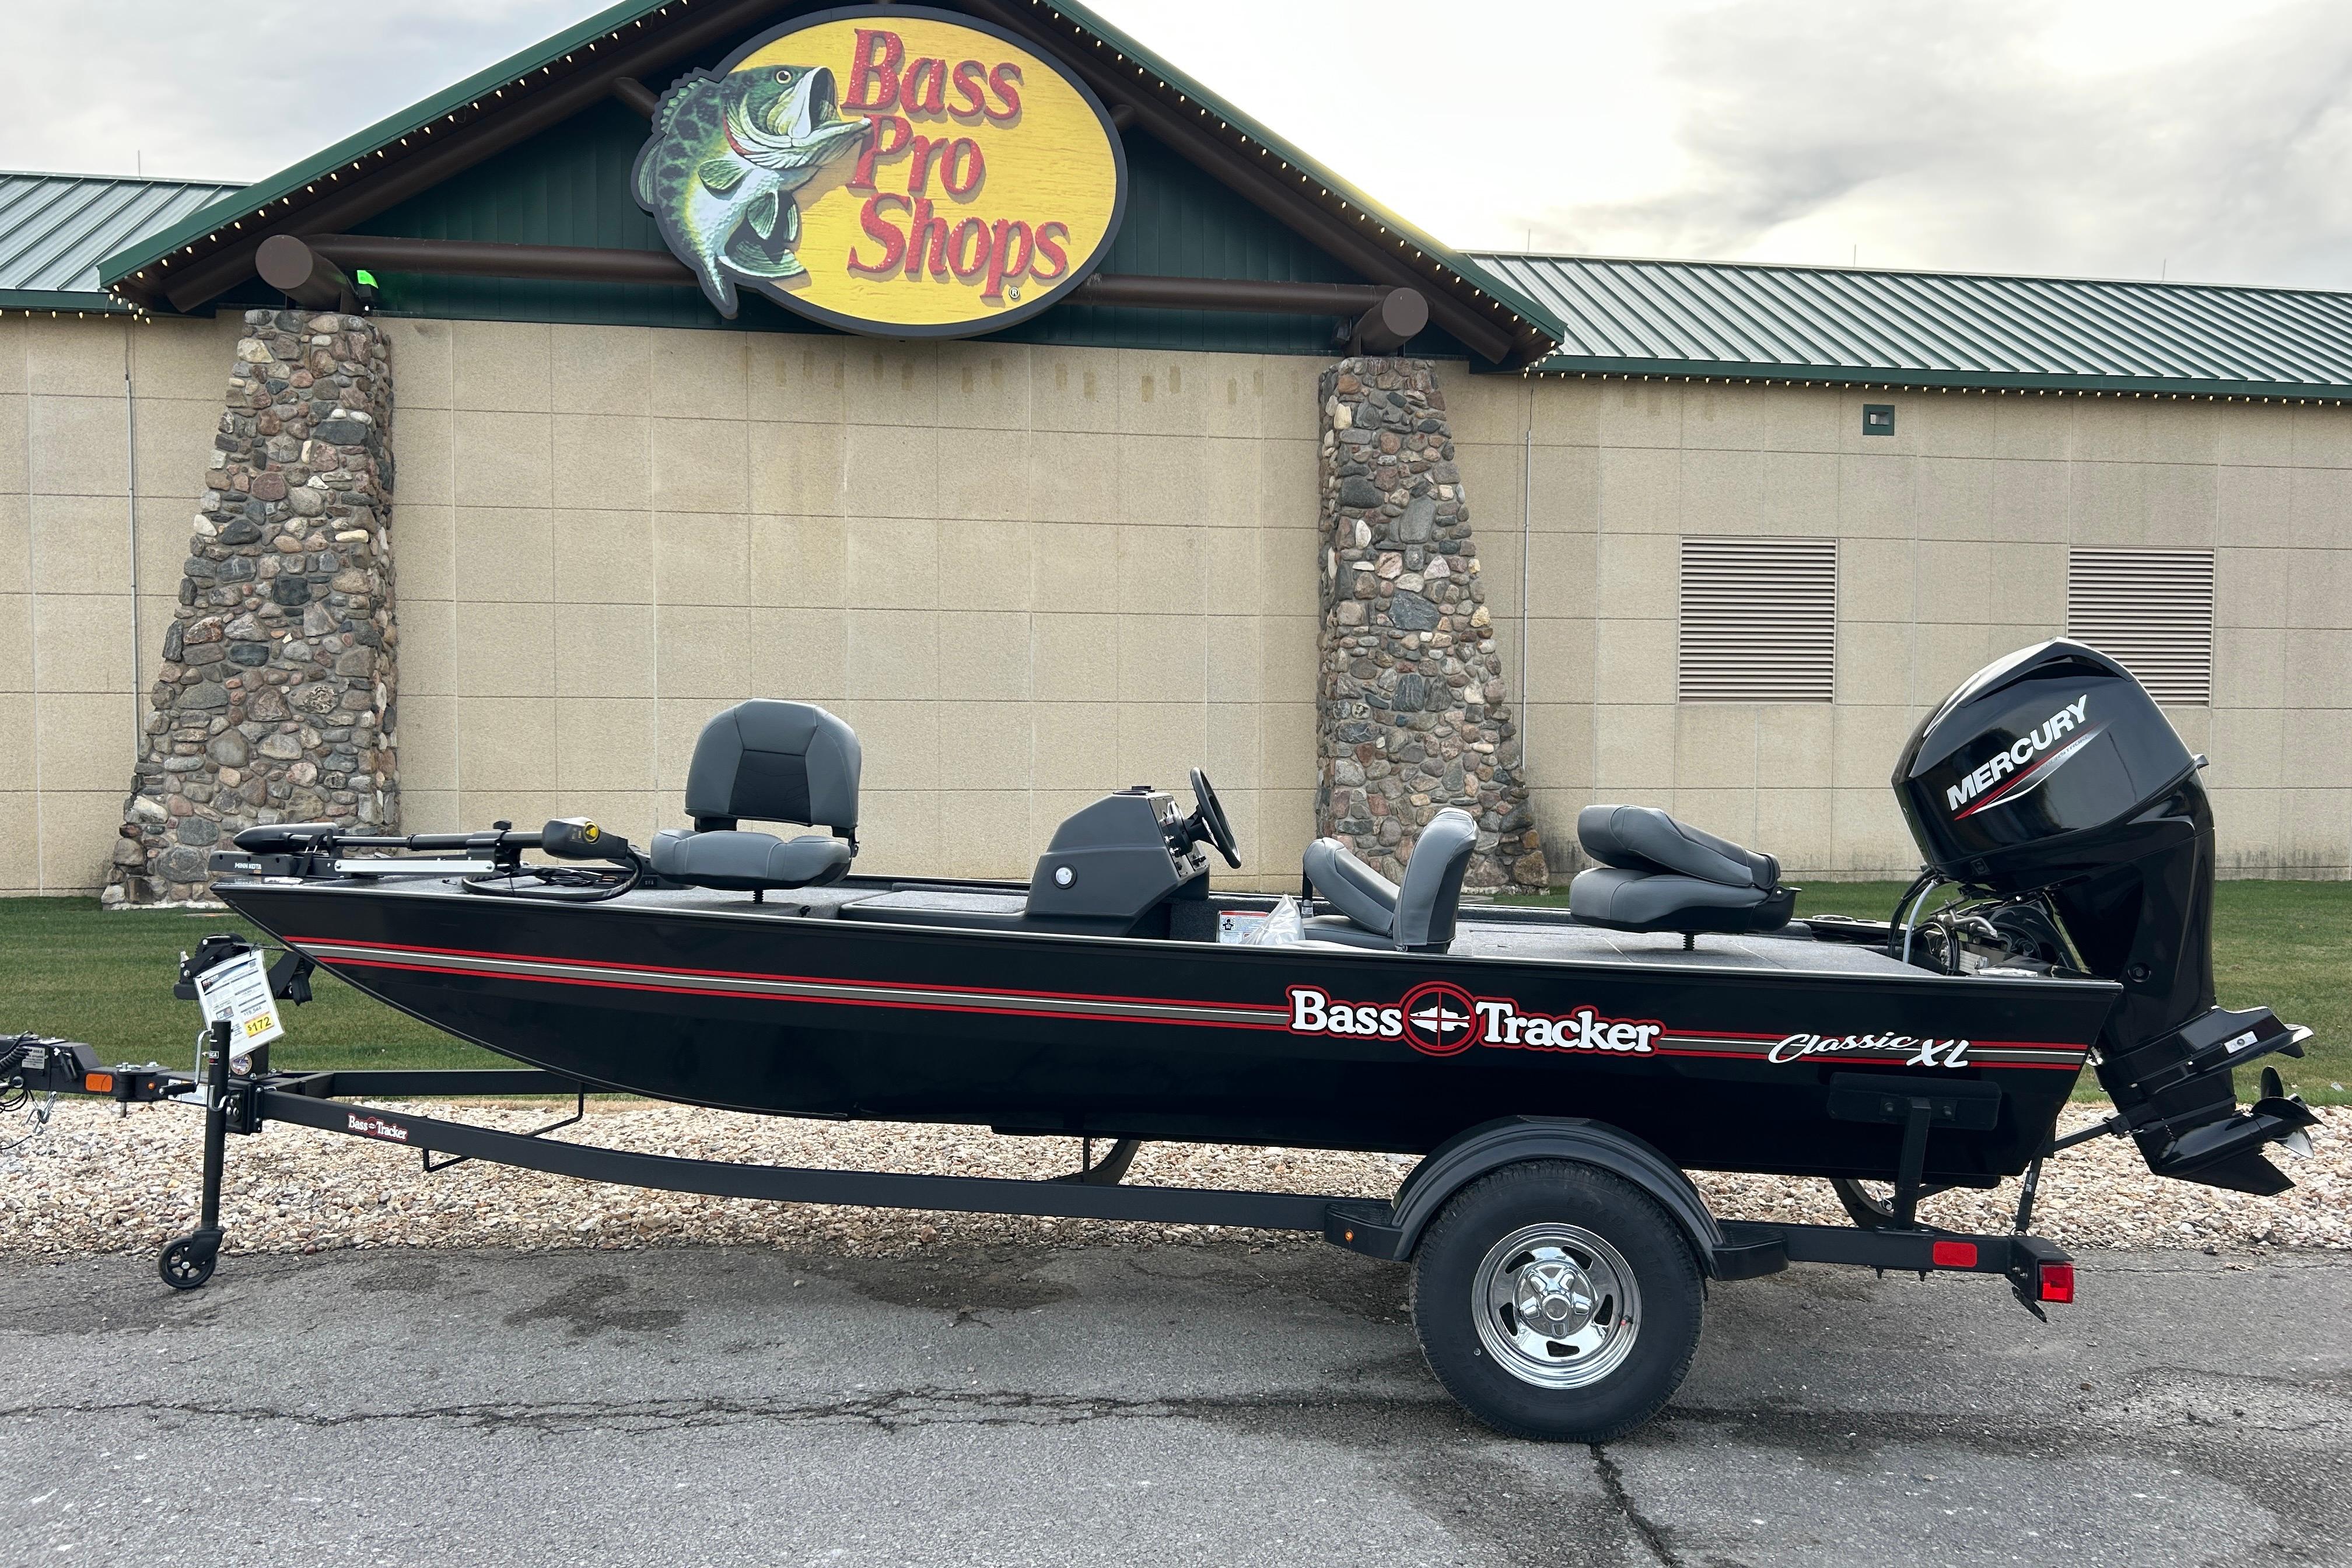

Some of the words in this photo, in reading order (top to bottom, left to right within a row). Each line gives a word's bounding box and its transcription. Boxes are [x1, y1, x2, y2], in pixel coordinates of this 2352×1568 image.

[839, 27, 1023, 120] Bass
[845, 113, 985, 195] Pro
[848, 192, 1070, 299] Shops
[1946, 694, 2087, 811] MERCURY
[247, 1016, 271, 1031] $172
[1292, 990, 1403, 1036] Bass
[1476, 1001, 1660, 1052] Tracker
[1768, 1031, 1919, 1063] Classic
[1906, 1039, 1968, 1068] XL
[348, 1115, 368, 1131] Bass
[376, 1121, 407, 1140] Tracker
